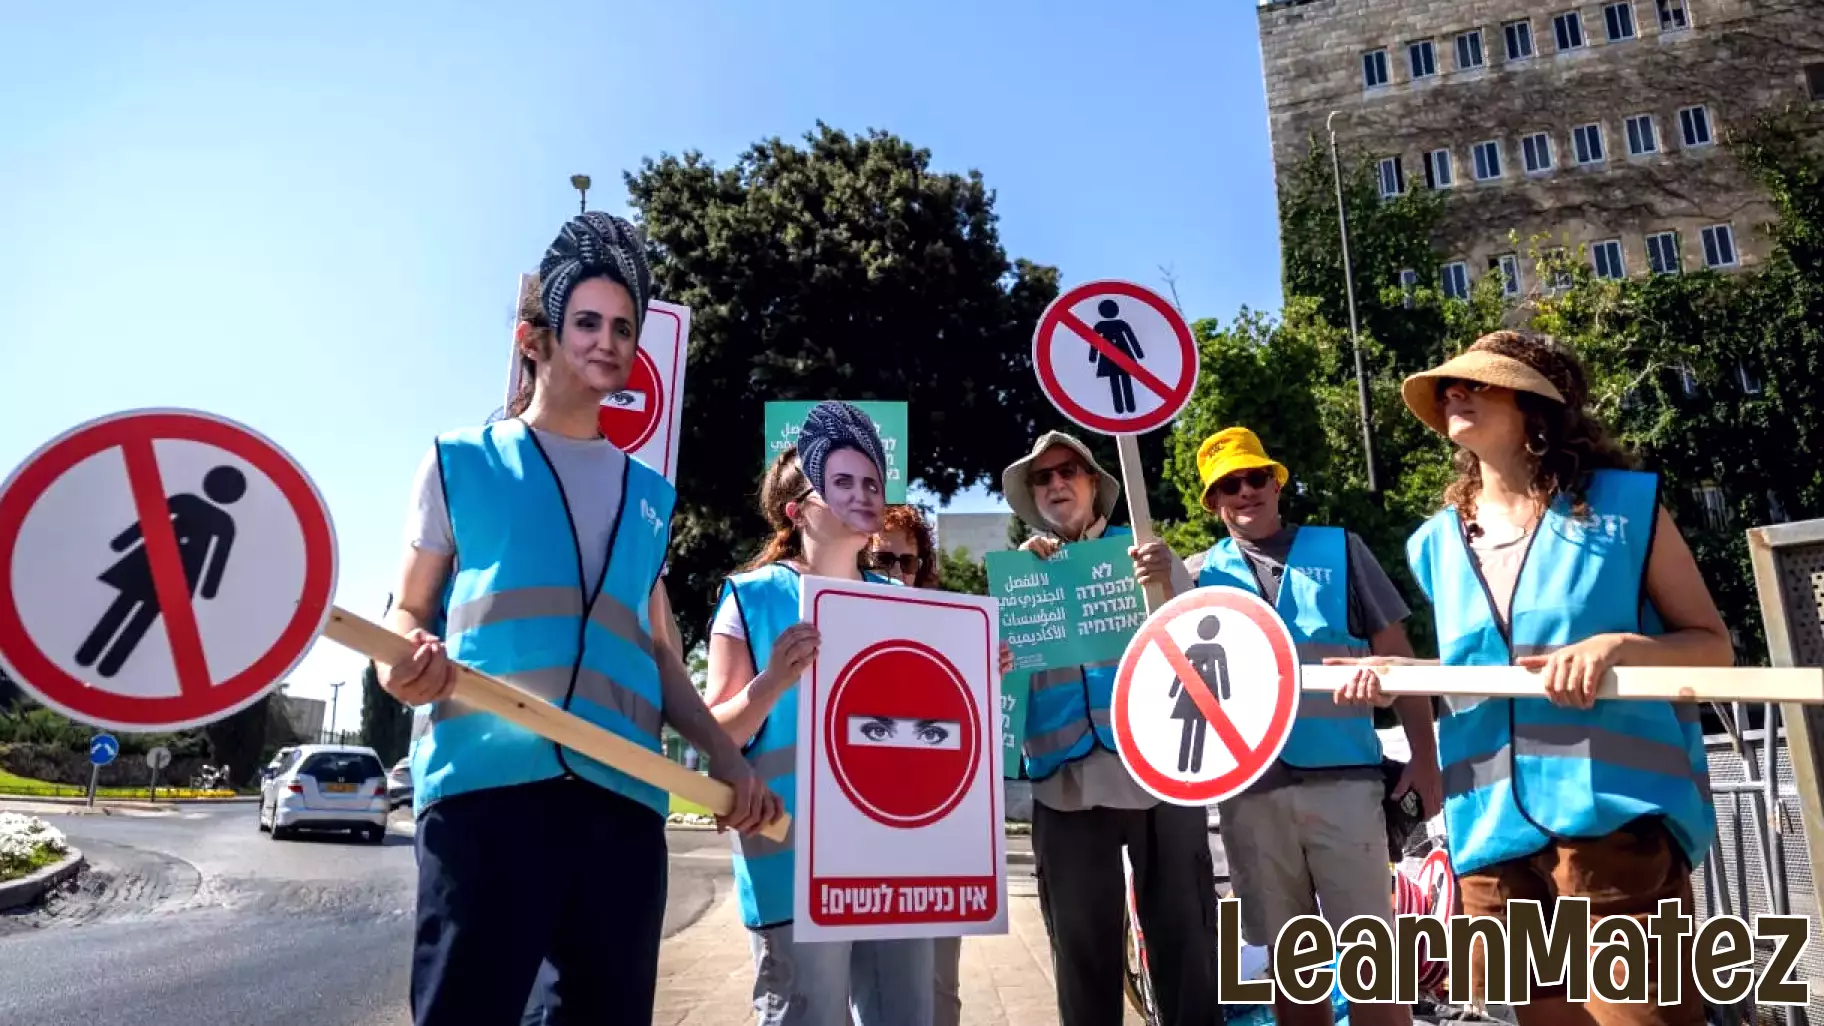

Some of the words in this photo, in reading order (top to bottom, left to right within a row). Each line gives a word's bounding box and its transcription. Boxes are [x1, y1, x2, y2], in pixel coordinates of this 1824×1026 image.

[1091, 561, 1113, 580] לא
[1019, 587, 1065, 608] الجندري
[1075, 575, 1135, 600] להפרדה
[1082, 597, 1137, 617] מגדרית
[821, 883, 895, 915] לנשים!
[899, 885, 955, 913] כניסה
[959, 885, 988, 916] אין
